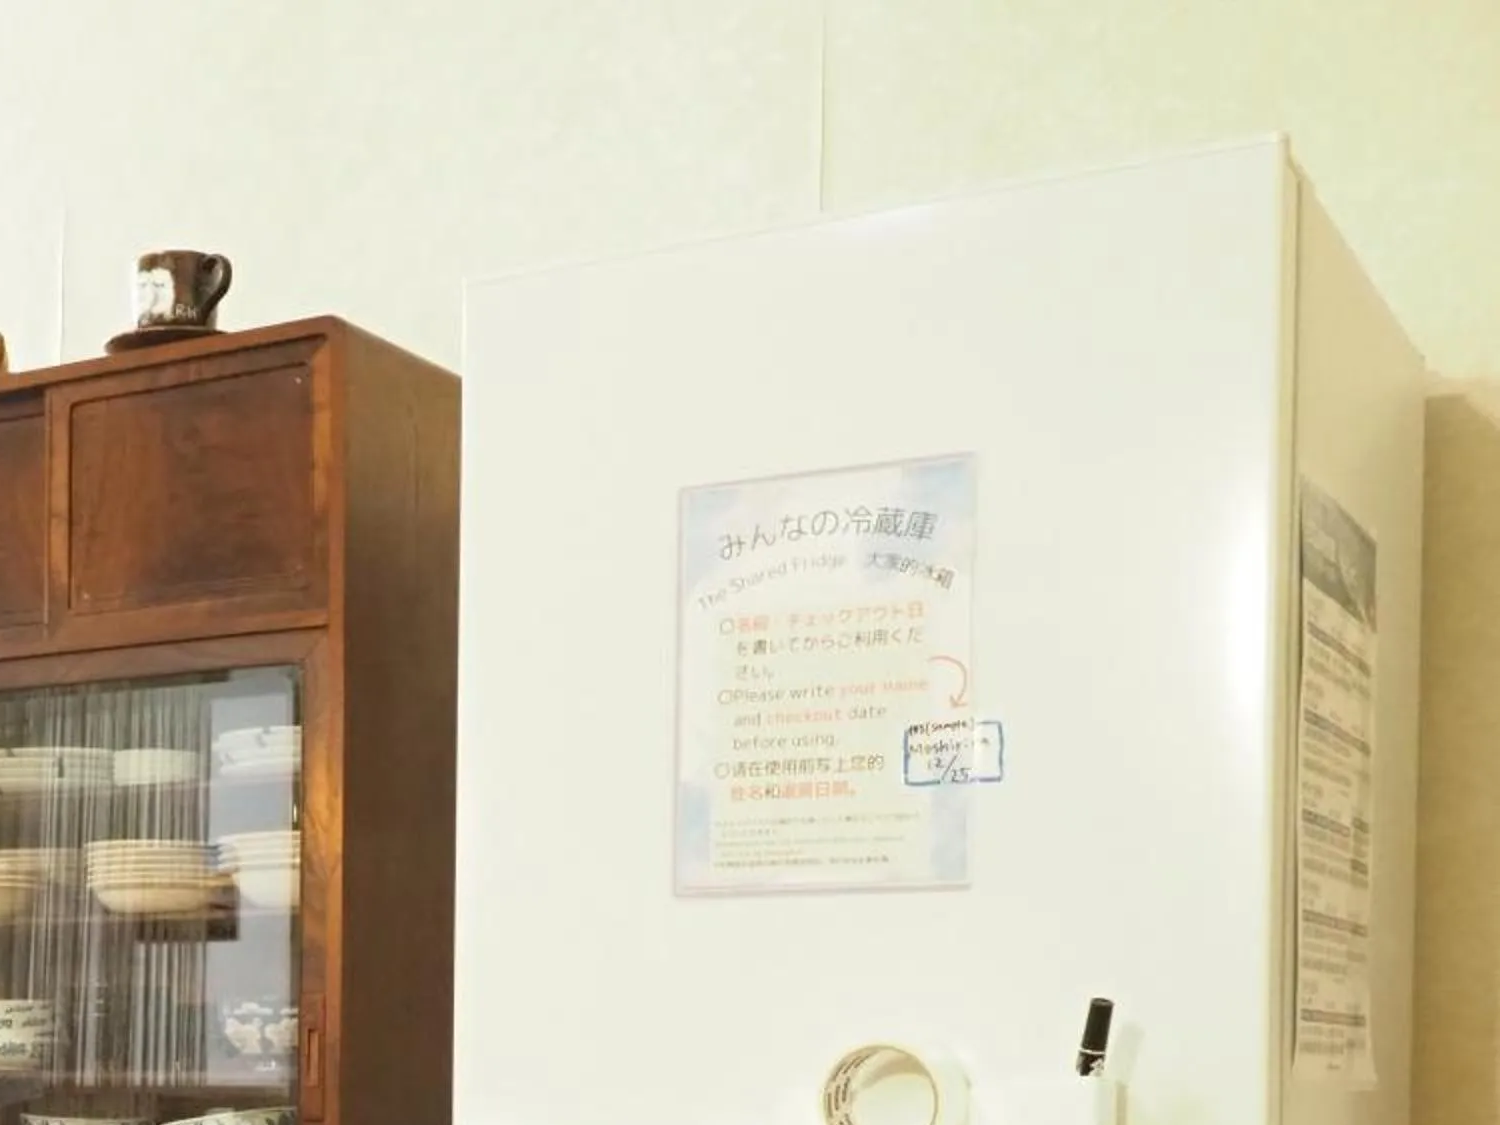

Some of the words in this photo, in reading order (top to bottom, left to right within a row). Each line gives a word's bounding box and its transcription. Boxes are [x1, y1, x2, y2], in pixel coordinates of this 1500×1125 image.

[718, 505, 938, 560] みんなの冷蔵庫
[789, 686, 835, 701] write
[840, 684, 879, 700] your
[733, 712, 762, 727] and
[766, 708, 843, 726] checkout
[847, 705, 888, 720] date
[732, 734, 787, 750] before
